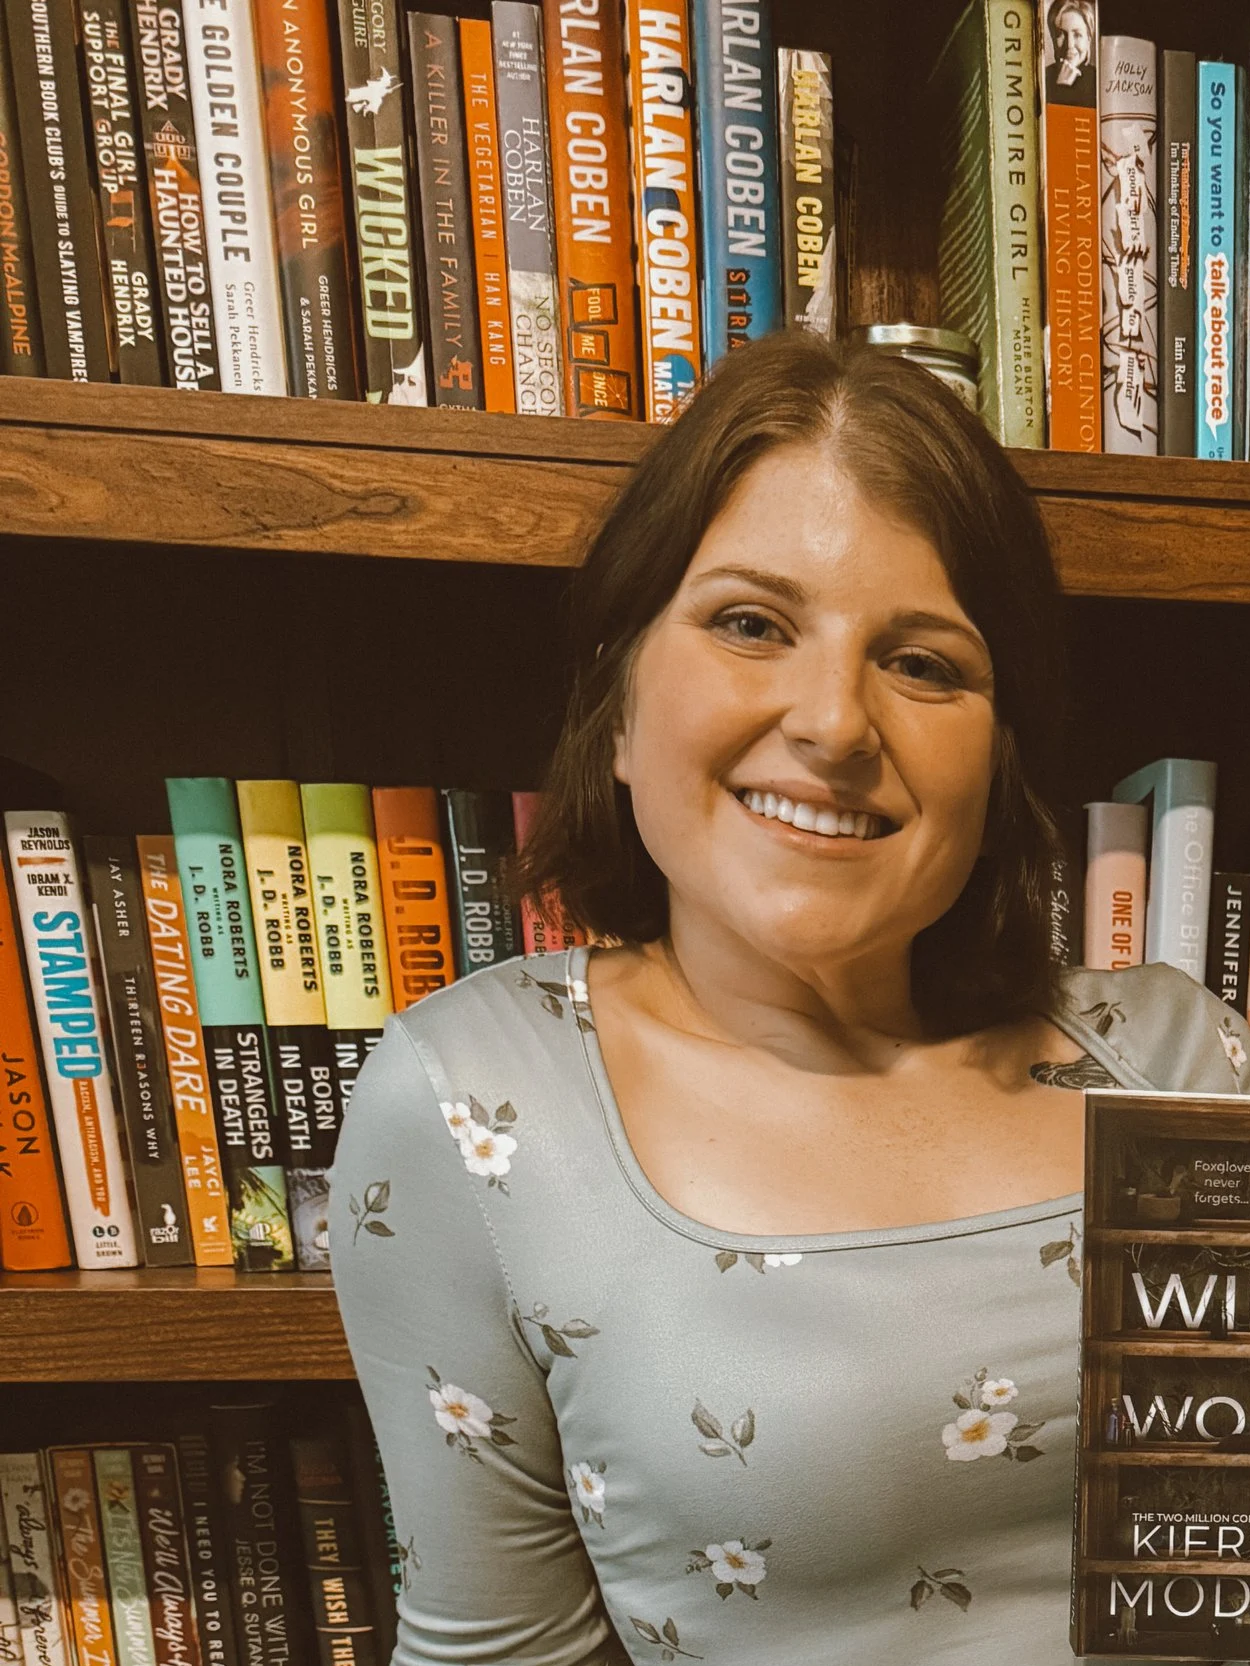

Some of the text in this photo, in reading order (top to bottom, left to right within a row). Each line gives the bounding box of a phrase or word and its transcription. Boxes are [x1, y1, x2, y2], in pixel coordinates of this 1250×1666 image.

[83, 11, 118, 193] SUPPORT GROUP
[106, 53, 137, 186] FINAL GIRL
[1105, 80, 1153, 96] JACKSON
[1114, 61, 1147, 77] HOLLY
[201, 24, 252, 263] GOLDEN COUPLE
[283, 20, 318, 250] ANONYMOUS GIRL
[503, 129, 526, 223] COBEN
[521, 117, 546, 233] HARLAN
[565, 110, 612, 244] COBEN
[638, 9, 694, 352] HARLAN COBEN
[792, 70, 824, 288] HARLAN COBEN
[1004, 10, 1028, 281] GRIMOIRE GIRL
[39, 80, 80, 305] BOOK CLUB'S SLAYING
[154, 168, 187, 306] HAUNTED
[353, 143, 414, 340] WICKED
[426, 64, 464, 347] KILLER THE FAMILY
[473, 122, 506, 366] VEGETARIAN KANG
[1074, 117, 1094, 338] HILLARY RODHAM
[1169, 161, 1179, 287] Thinking Things
[111, 259, 135, 347] HENDRIX
[131, 271, 154, 341] GRADY
[190, 301, 212, 356] SELL
[243, 281, 263, 392] Greer Hendricks
[1054, 187, 1074, 392] LIVING HISTORY
[1124, 167, 1139, 401] good guide murder
[1211, 163, 1226, 420] want to talk about race
[229, 325, 242, 387] Pekkanen
[321, 309, 338, 391] HENDRICKS
[1013, 329, 1024, 397] MORGAN
[1022, 297, 1034, 428] HILARIE BURTON
[1174, 337, 1186, 393] Iain Reid
[20, 839, 71, 852] REYNOLDS
[27, 827, 60, 839] JASON
[27, 873, 60, 885] IBRAM
[1180, 845, 1204, 916] Office
[37, 885, 68, 897] KENDI
[218, 844, 250, 980] NORA ROBERTS
[1112, 890, 1133, 927] ONE
[1221, 885, 1243, 1002] JENNIFER
[32, 909, 102, 1080] STAMPED
[147, 898, 207, 1115] DATING DARE
[2, 1052, 41, 1155] JASON
[236, 1032, 273, 1162] STRANGERS
[282, 1077, 312, 1151] DEATH
[310, 1066, 337, 1131] BORN
[200, 1145, 221, 1198] JAYCI
[1194, 1191, 1250, 1207] forgets...
[1203, 1177, 1242, 1189] never
[1185, 1512, 1231, 1524] MILLION
[257, 1540, 283, 1609] DONE
[321, 1576, 350, 1625] WISH
